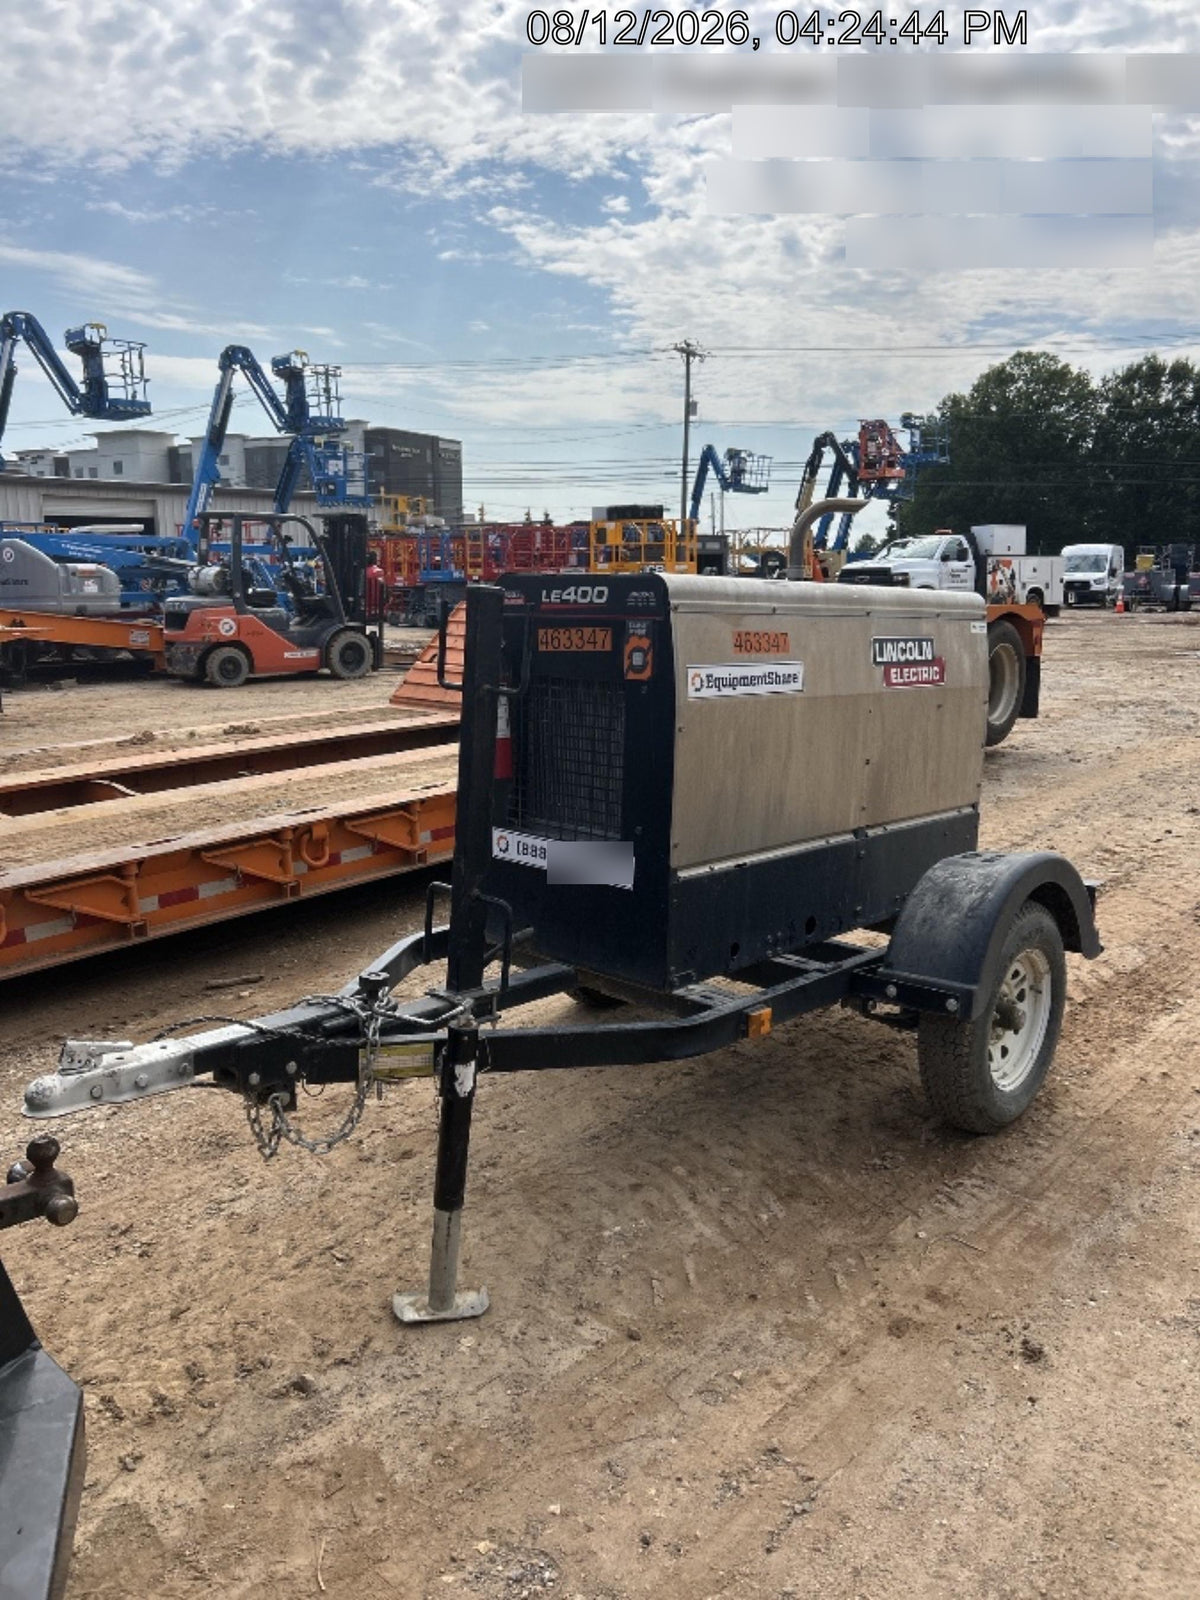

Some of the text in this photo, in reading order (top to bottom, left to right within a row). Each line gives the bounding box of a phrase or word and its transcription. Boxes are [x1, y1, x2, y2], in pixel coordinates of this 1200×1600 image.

[541, 586, 609, 604] LE400
[539, 629, 610, 650] 463347
[733, 631, 789, 653] 463347
[875, 641, 933, 662] LINCOLN
[705, 671, 800, 692] EquipmentShare
[890, 666, 940, 683] ELECTRIC
